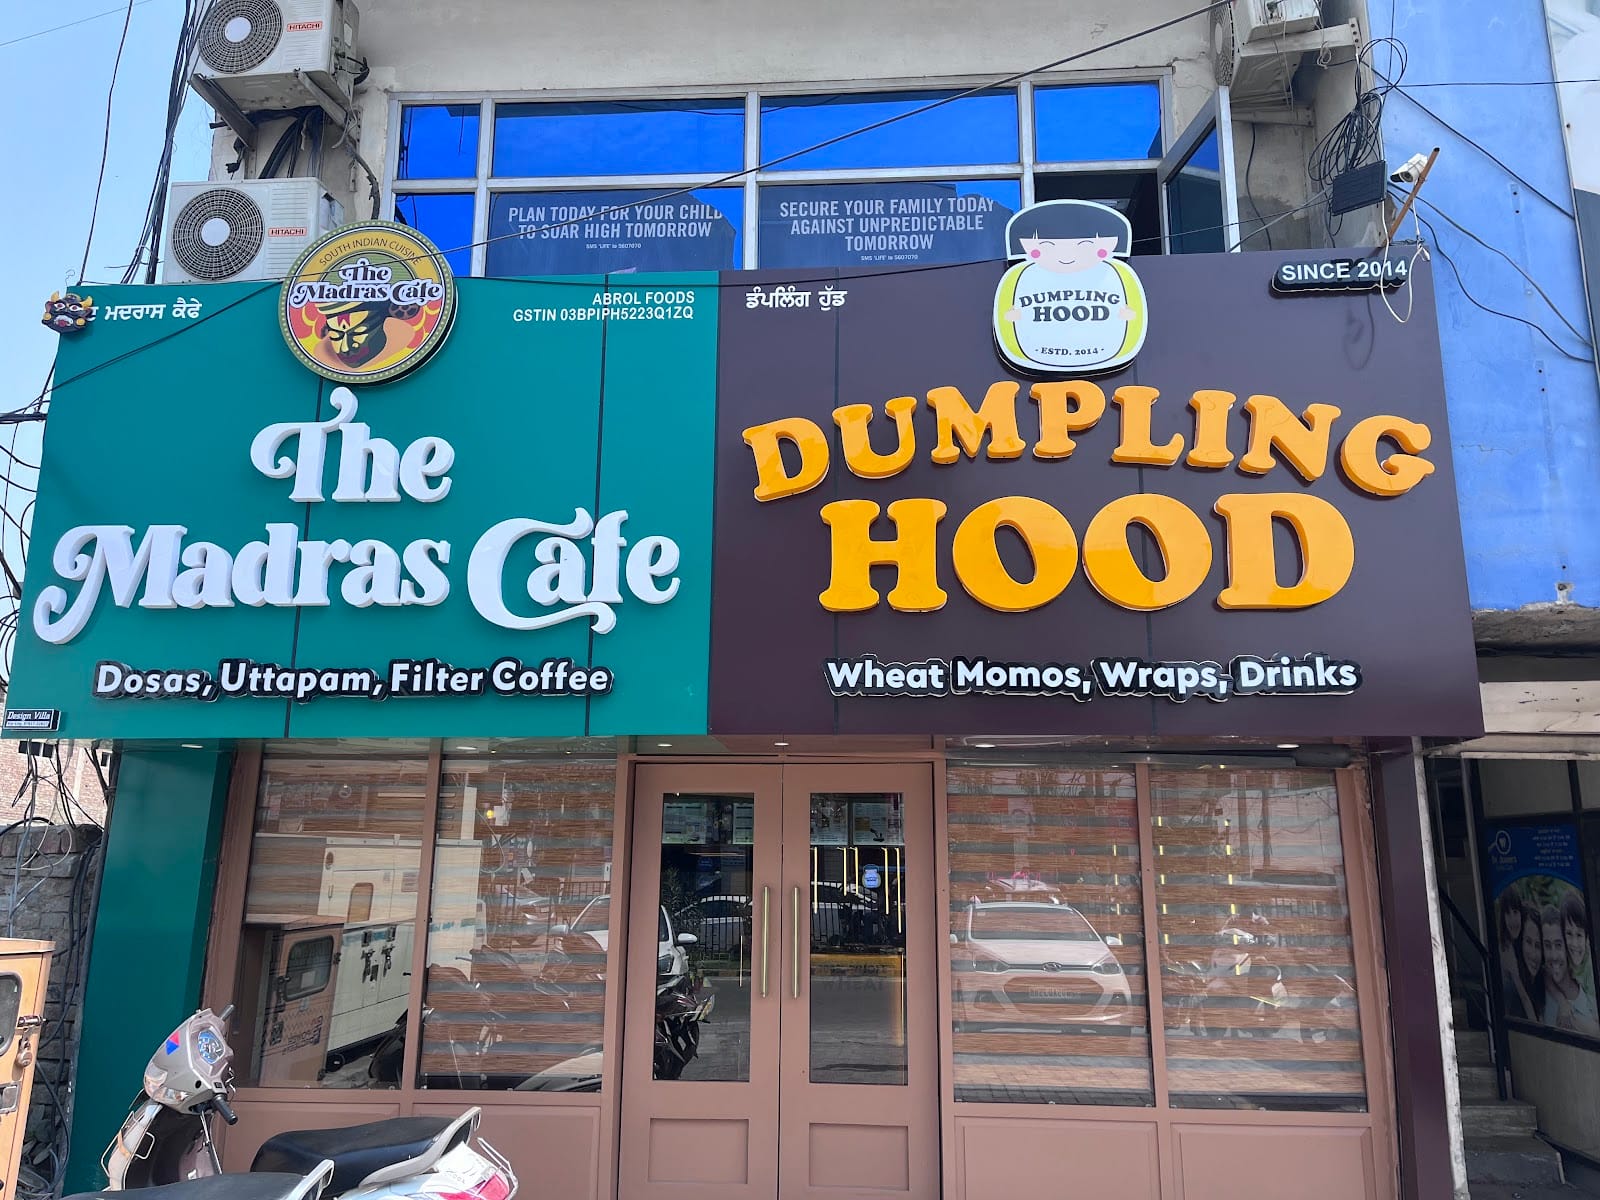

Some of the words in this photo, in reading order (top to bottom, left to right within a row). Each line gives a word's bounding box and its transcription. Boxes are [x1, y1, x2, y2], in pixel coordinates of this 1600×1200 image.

[289, 23, 321, 31] HITACHI
[508, 206, 546, 222] PLAN
[551, 206, 597, 222] TODAY
[600, 205, 630, 221] FOR
[634, 204, 676, 220] YOUR
[679, 203, 724, 220] CHILD
[780, 201, 840, 217] SECURE
[844, 200, 885, 216] YOUR
[889, 198, 944, 215] FAMILY
[949, 197, 995, 213] TODAY
[518, 224, 537, 240] TO
[540, 223, 580, 239] SOAR
[584, 222, 621, 238] HIGH
[625, 221, 713, 238] TOMORROW
[790, 218, 855, 235] AGAINST
[859, 214, 984, 233] UNPREDICTABLE
[319, 243, 351, 266] SOUTH
[351, 237, 388, 249] INDIAN
[388, 240, 422, 266] CUISINE
[845, 233, 934, 252] TOMORROW
[339, 258, 391, 282] The
[1281, 262, 1351, 281] SINCE
[1357, 260, 1408, 278] 2014
[291, 282, 388, 307] Madras
[592, 292, 641, 305] ABROL
[645, 290, 695, 304] FOODS
[745, 286, 811, 309] ਡੰਪਲਿੰਗ
[818, 285, 848, 311] ਹੁੱਡ
[1018, 289, 1120, 308] DUMPLING
[104, 304, 166, 321] ਮਦਰਾਸ
[171, 297, 203, 319] ਕੈਫੇ
[513, 308, 557, 322] GSTIN
[560, 306, 694, 321] 03BPIPH5223Q1ZQ
[1032, 305, 1110, 322] HOOD
[1040, 347, 1072, 356] ESTD.
[1074, 347, 1099, 355] 2014
[250, 386, 455, 503] The
[741, 380, 1435, 502] DUMPLING
[818, 493, 1355, 613] HOOD
[33, 522, 452, 645] Madras
[96, 664, 216, 698] Dosas,
[219, 662, 382, 699] Uttapam,
[390, 662, 485, 694] Filter
[492, 659, 609, 693] Coffee
[826, 660, 945, 691] Wheat
[957, 659, 1092, 697] Momos,
[1099, 659, 1229, 701] Wraps,
[1239, 655, 1357, 689] Drinks
[7, 711, 32, 721] Design
[34, 711, 51, 720] Villa
